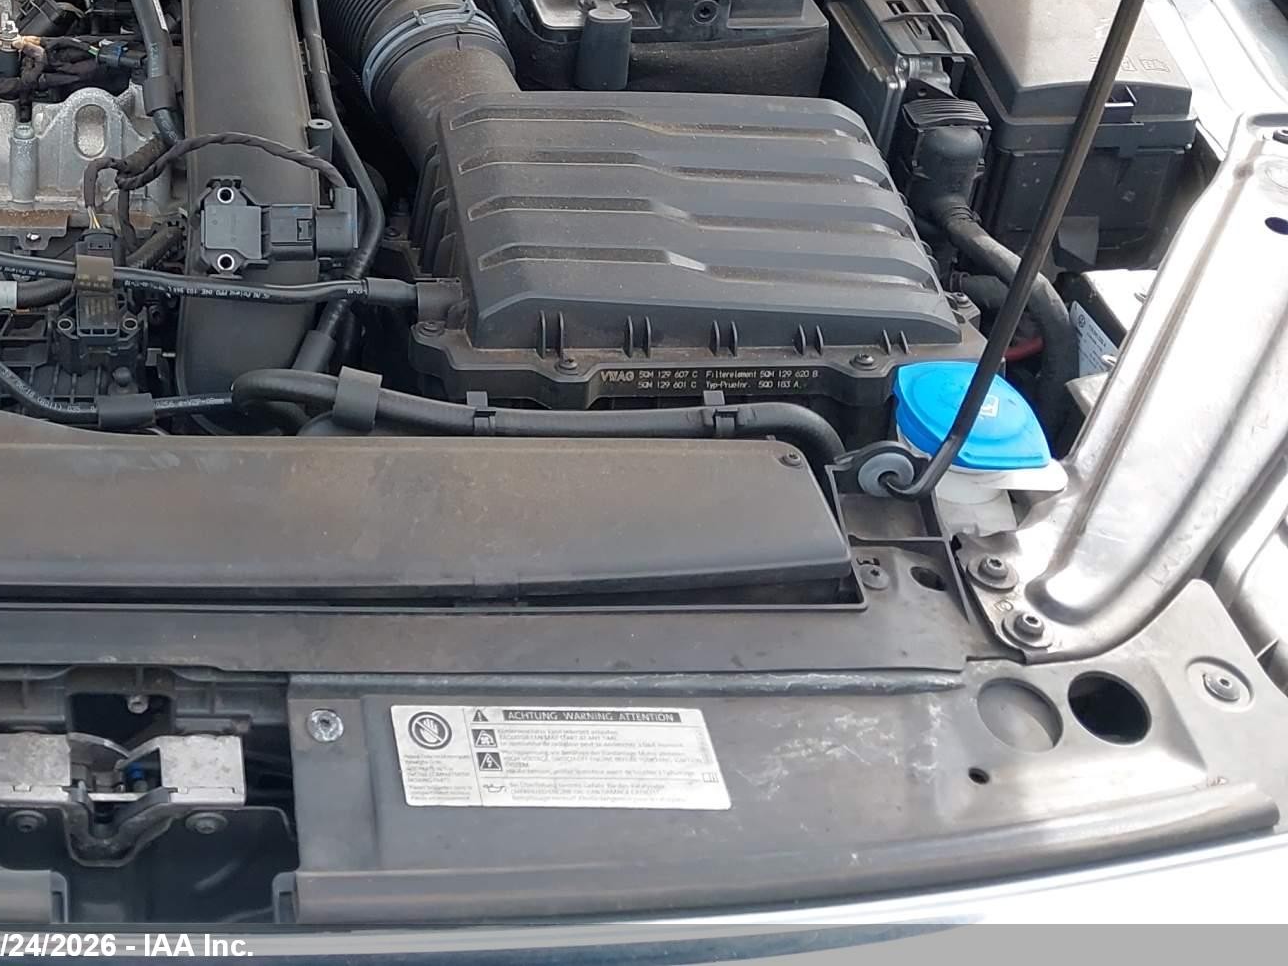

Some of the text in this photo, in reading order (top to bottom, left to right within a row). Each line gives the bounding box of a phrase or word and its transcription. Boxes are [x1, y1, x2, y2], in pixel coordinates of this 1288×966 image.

[657, 370, 671, 378] 129
[674, 370, 689, 378] 607
[692, 370, 698, 378] C
[706, 370, 756, 378] Filterelement
[778, 370, 792, 378] 129
[795, 370, 809, 378] 620
[657, 380, 671, 388] 129
[673, 380, 689, 388] 601
[508, 711, 674, 722] ACHTUNG WARNING ATTENTION
